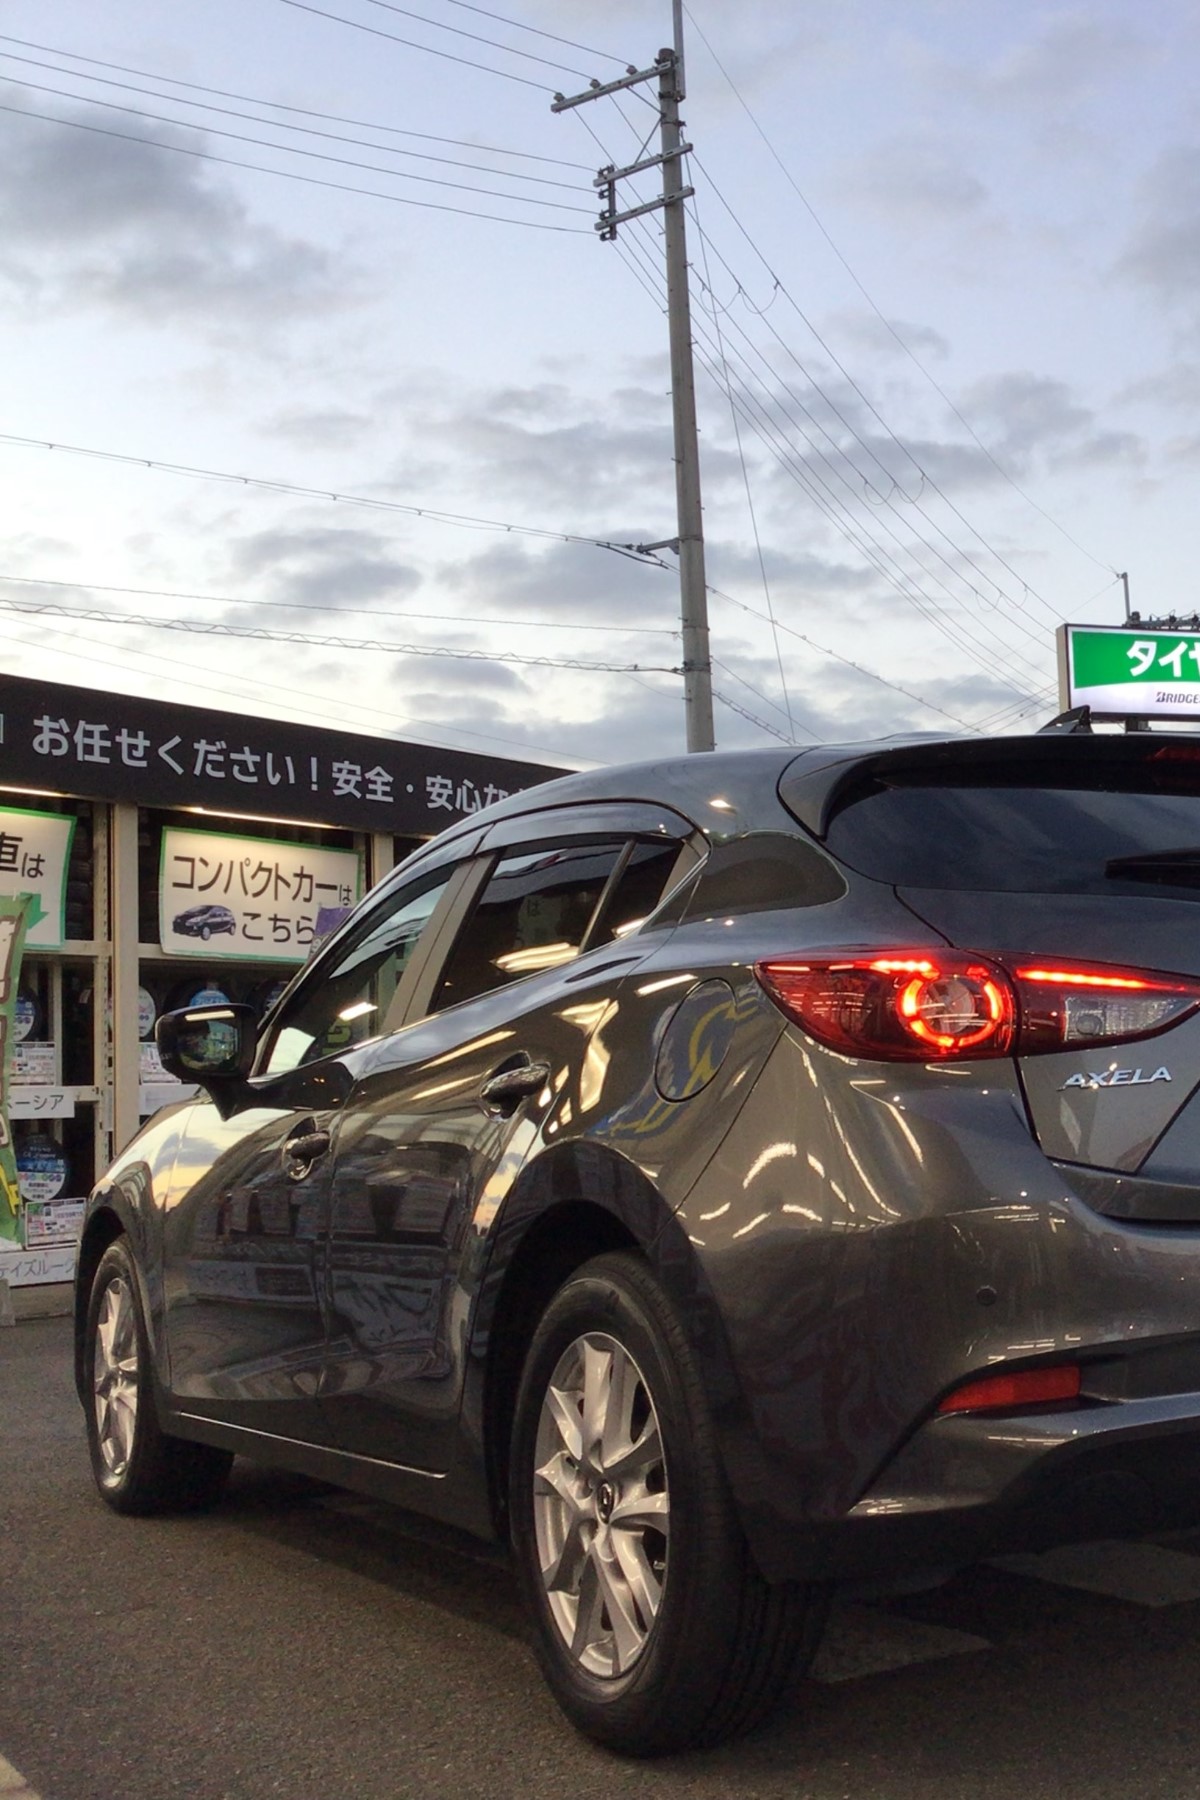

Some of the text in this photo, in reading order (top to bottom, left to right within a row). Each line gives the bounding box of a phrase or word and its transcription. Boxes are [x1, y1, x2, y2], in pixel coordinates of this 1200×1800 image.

[172, 856, 352, 906] コンパクトカーは
[241, 911, 316, 945] こちら
[1057, 1066, 1172, 1091] AXELA
